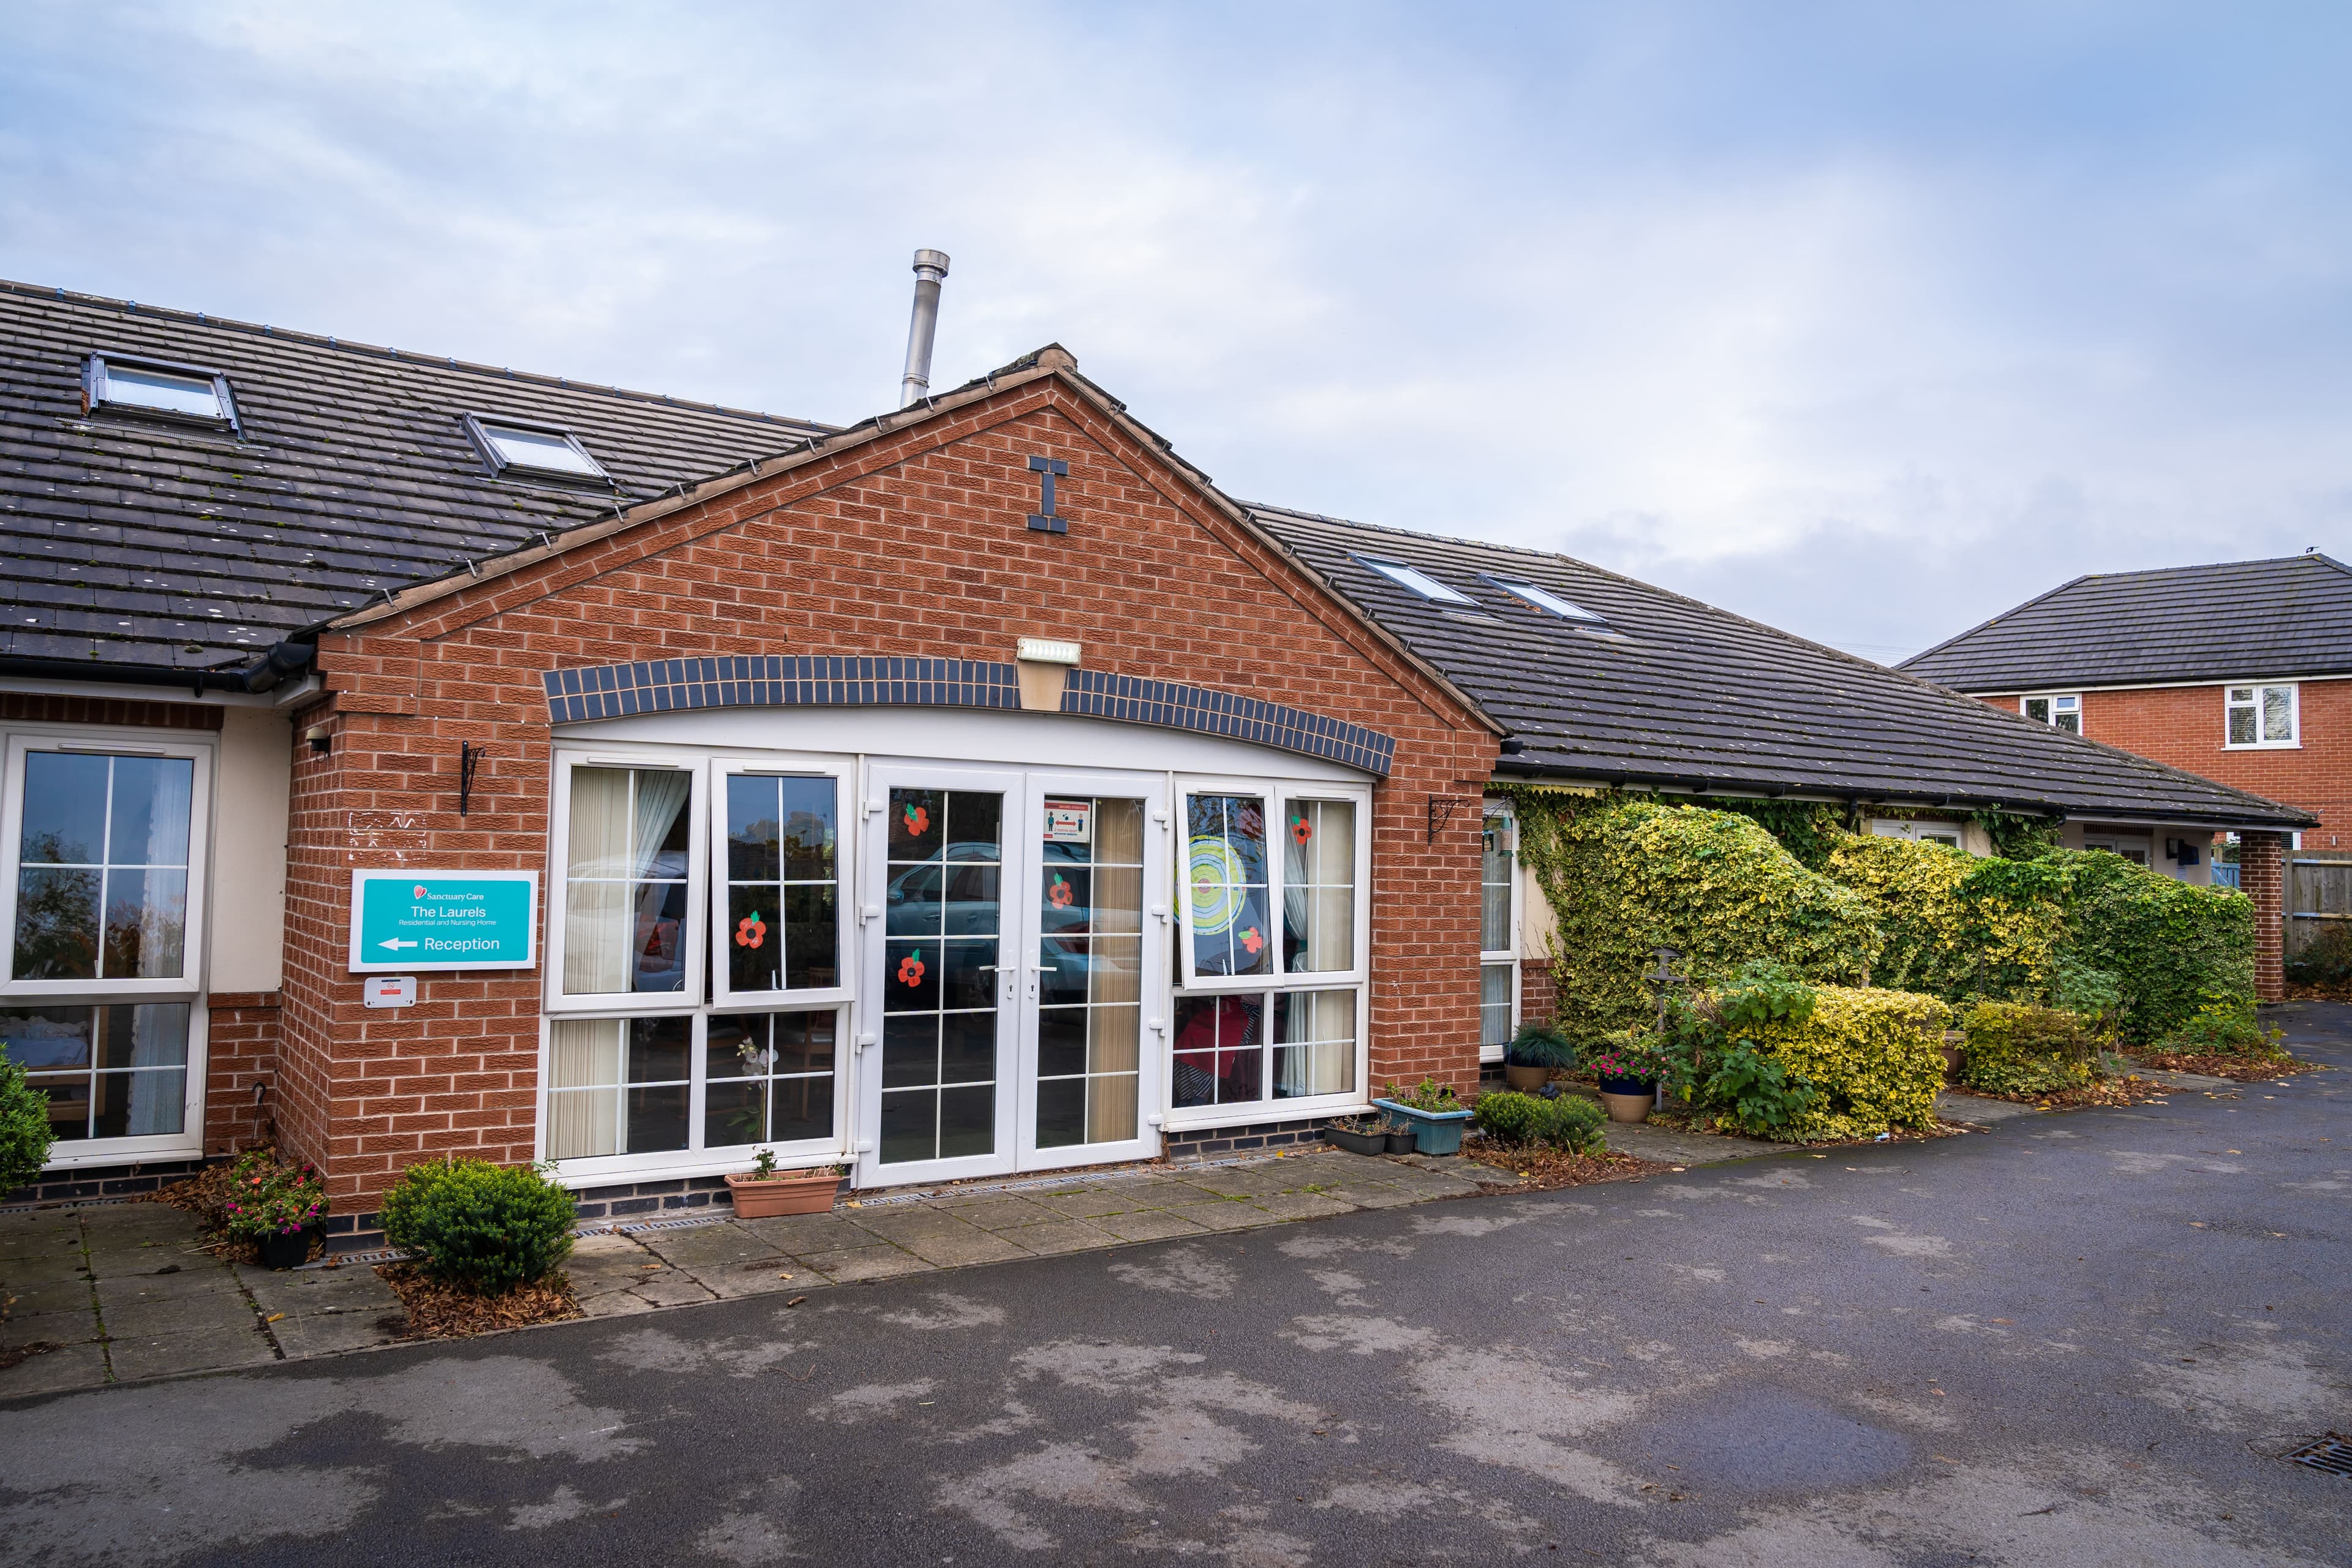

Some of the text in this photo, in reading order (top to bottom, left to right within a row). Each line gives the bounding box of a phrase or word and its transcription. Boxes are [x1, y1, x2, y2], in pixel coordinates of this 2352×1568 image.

[427, 893, 466, 902] Sanctuary
[411, 907, 486, 918] The Laurels
[424, 938, 500, 953] Reception
